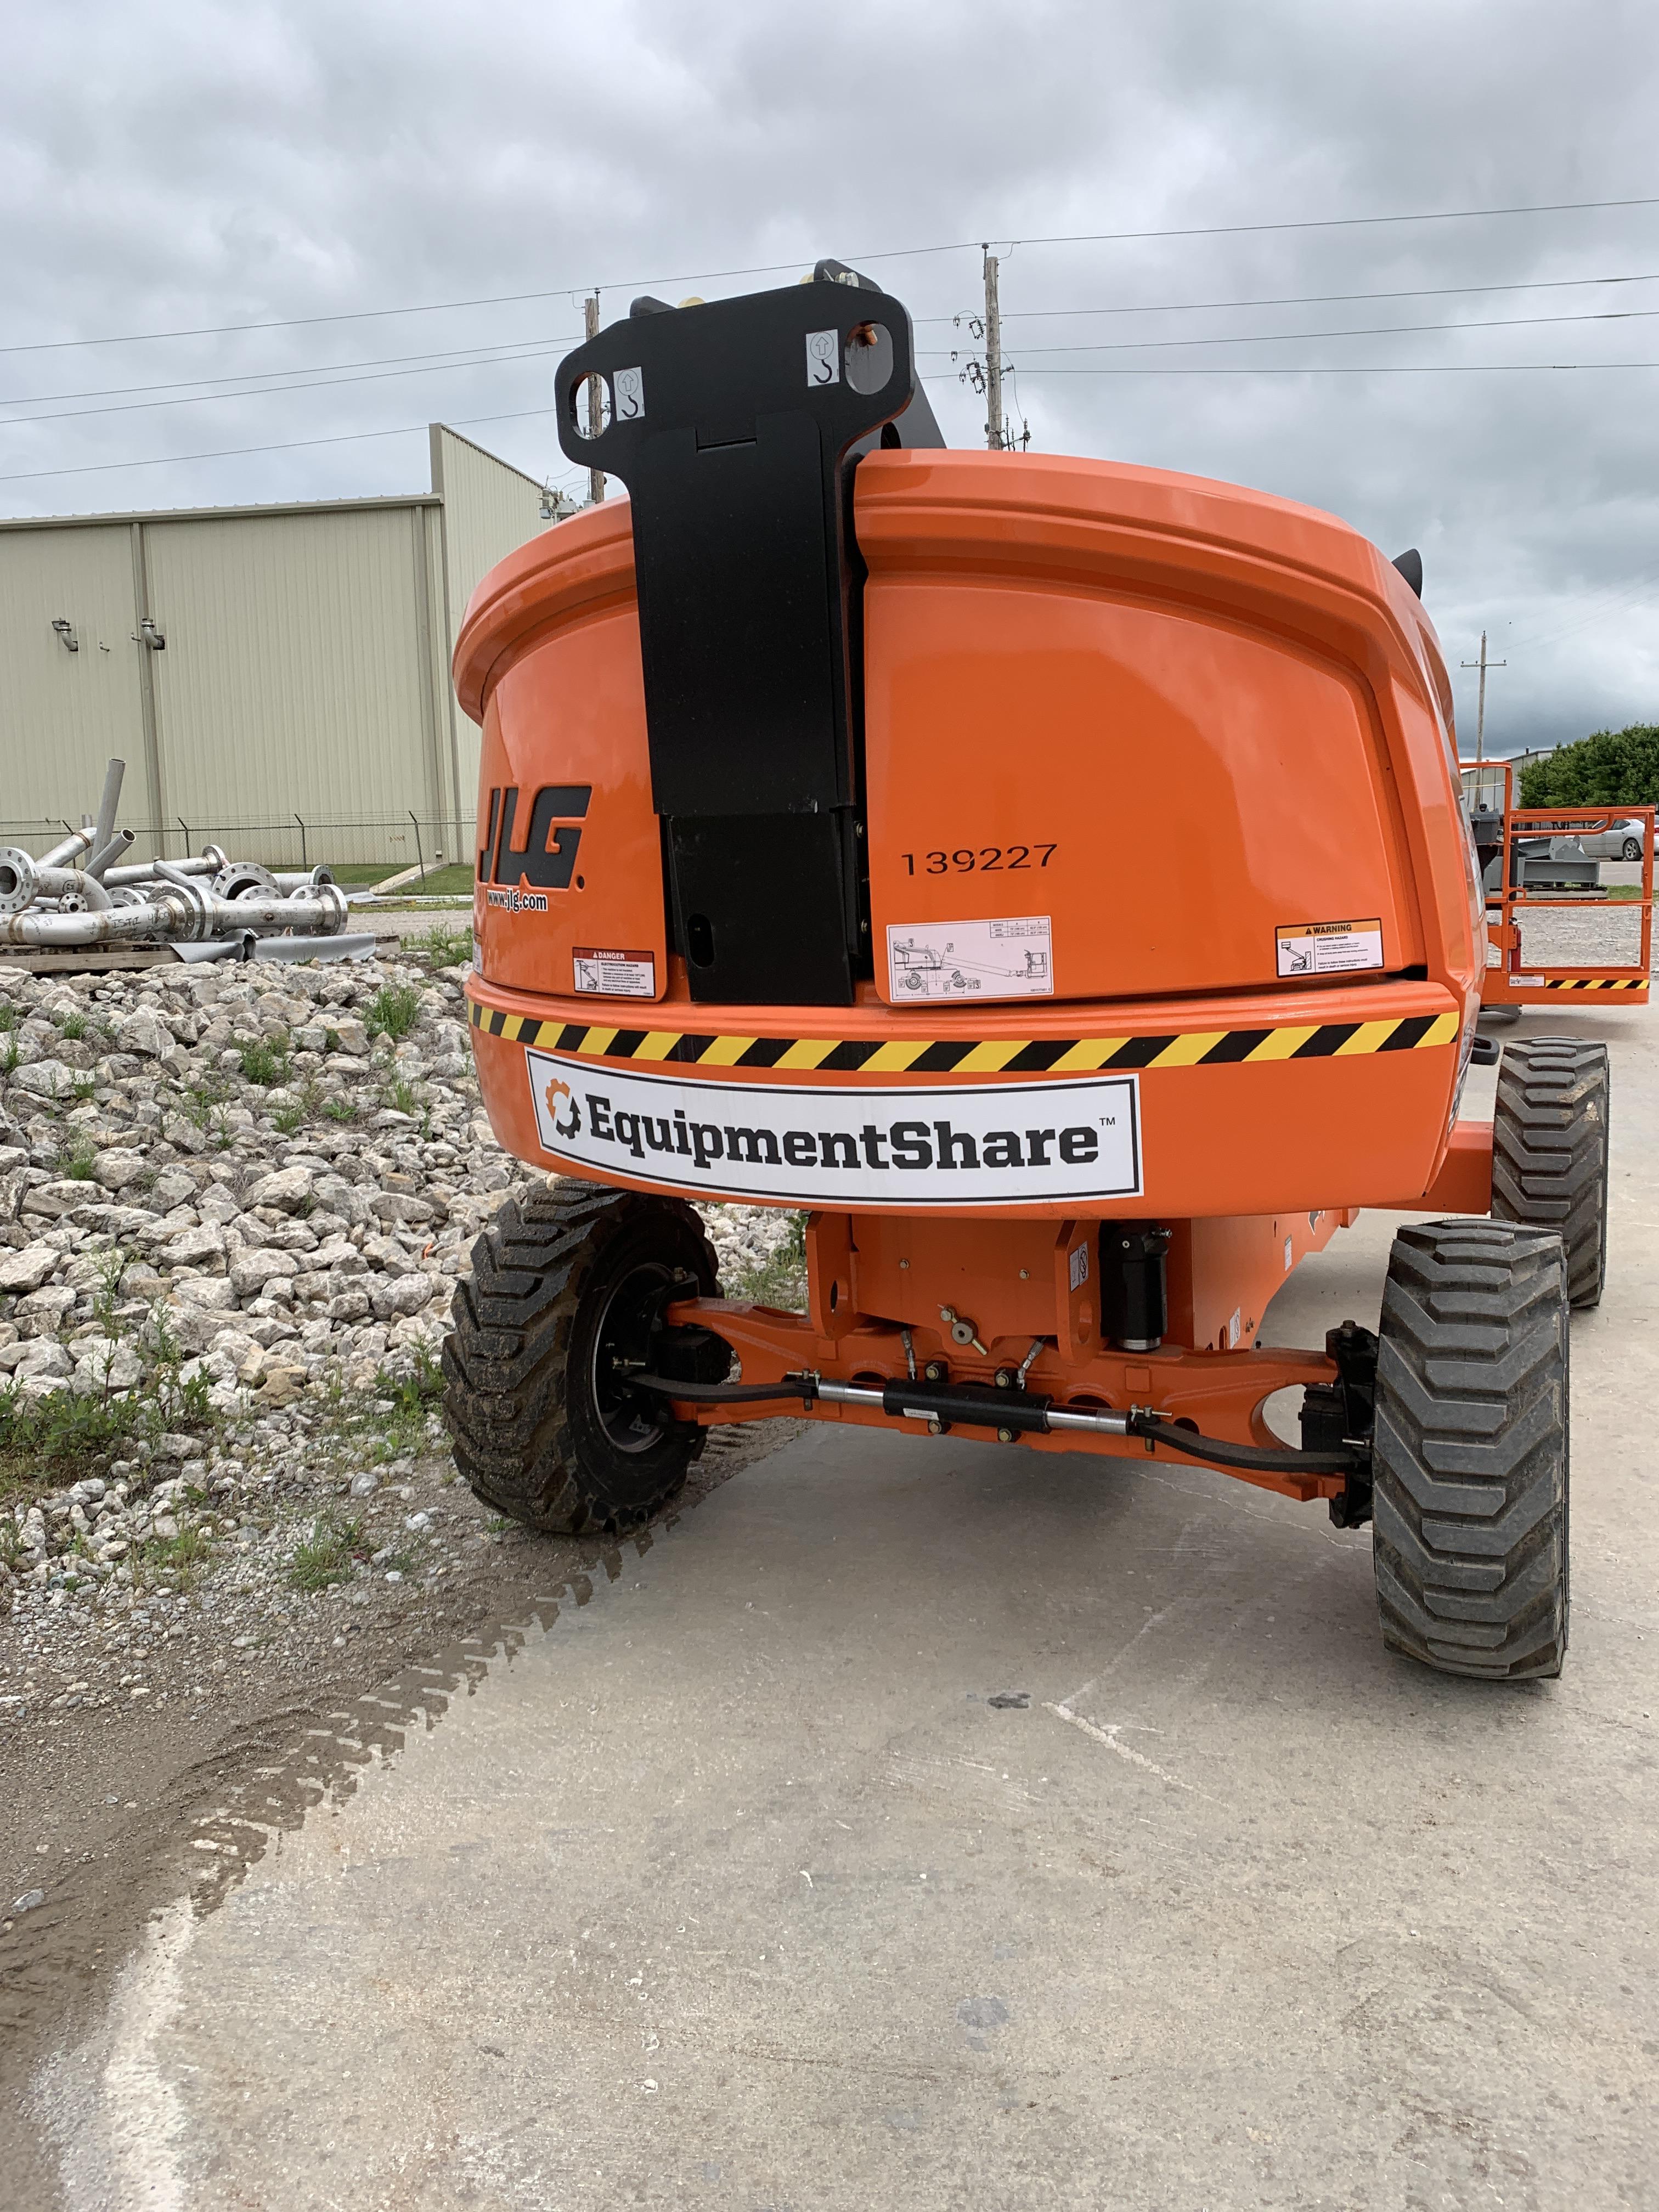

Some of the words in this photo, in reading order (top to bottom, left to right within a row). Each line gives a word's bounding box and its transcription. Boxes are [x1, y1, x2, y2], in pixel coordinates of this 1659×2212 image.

[479, 787, 592, 888] JLG
[901, 844, 1057, 876] 139227
[487, 889, 548, 912] www.jlg.com
[1313, 924, 1352, 934] WARNING
[598, 952, 625, 960] DANGER
[585, 1093, 1099, 1170] EquipmentShare
